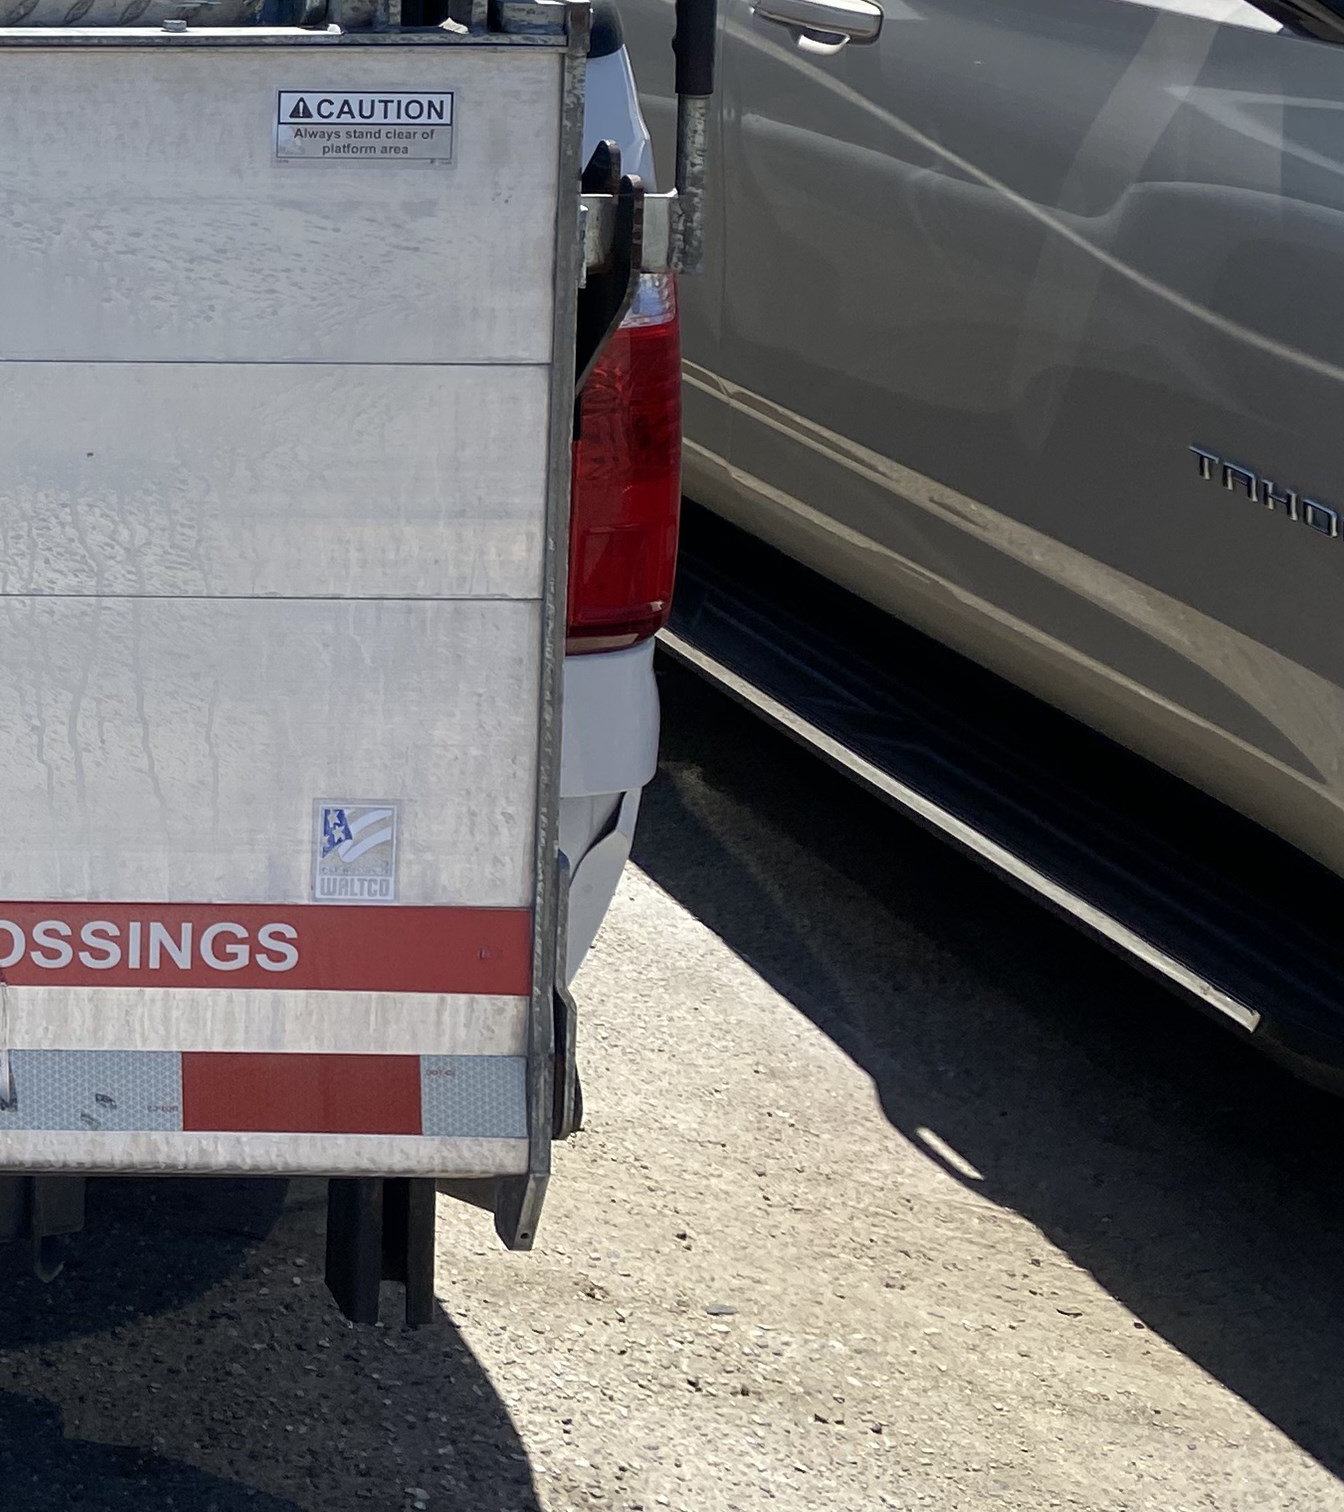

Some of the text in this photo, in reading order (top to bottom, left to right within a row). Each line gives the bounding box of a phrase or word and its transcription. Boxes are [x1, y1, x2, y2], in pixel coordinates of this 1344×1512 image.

[316, 98, 445, 120] CAUTION
[294, 128, 435, 141] Always stand clear of
[322, 143, 409, 156] platform area
[1188, 445, 1344, 542] TAHO
[320, 877, 391, 897] WALTCO
